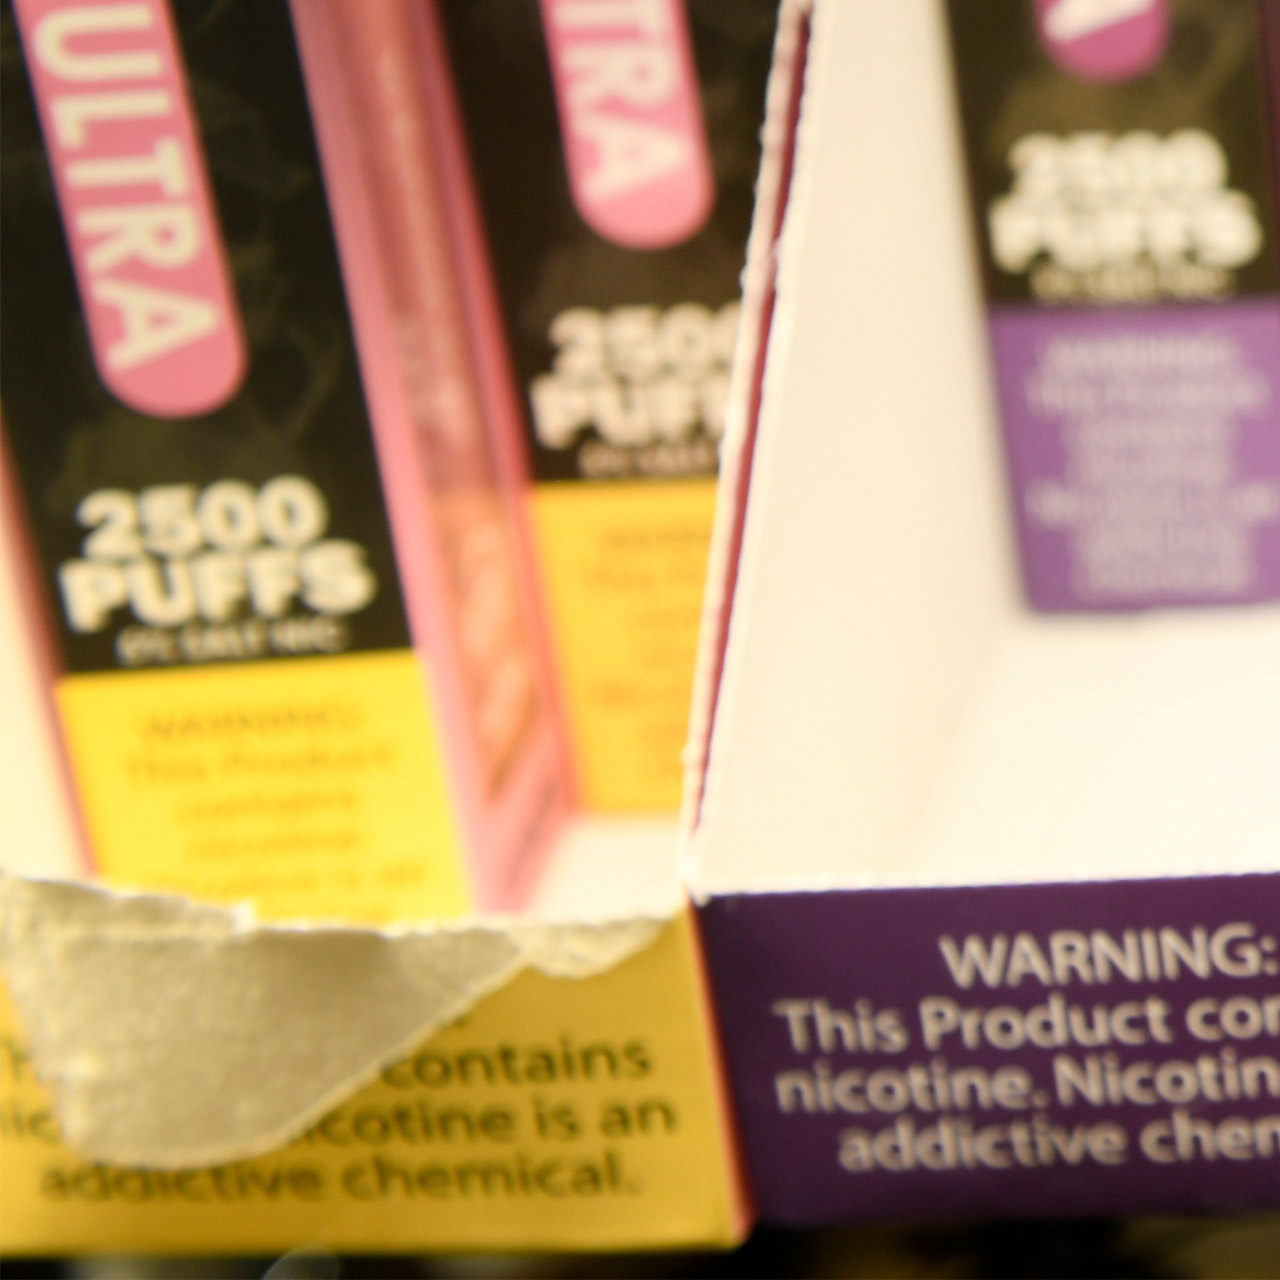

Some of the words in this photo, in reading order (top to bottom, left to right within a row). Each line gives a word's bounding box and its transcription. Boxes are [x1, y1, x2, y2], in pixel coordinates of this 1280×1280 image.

[32, 1, 222, 374] ULTRA
[76, 475, 329, 561] 2500
[58, 539, 377, 632] PUFFS
[939, 923, 1280, 988] WARNING:
[772, 997, 909, 1054] This
[918, 993, 1172, 1053] Product
[773, 1060, 1048, 1113] nicotine.
[298, 1098, 516, 1150] cotine
[526, 1092, 578, 1141] is
[599, 1092, 678, 1136] an
[838, 1115, 1128, 1172] addictive
[341, 1152, 642, 1203] chemical.
